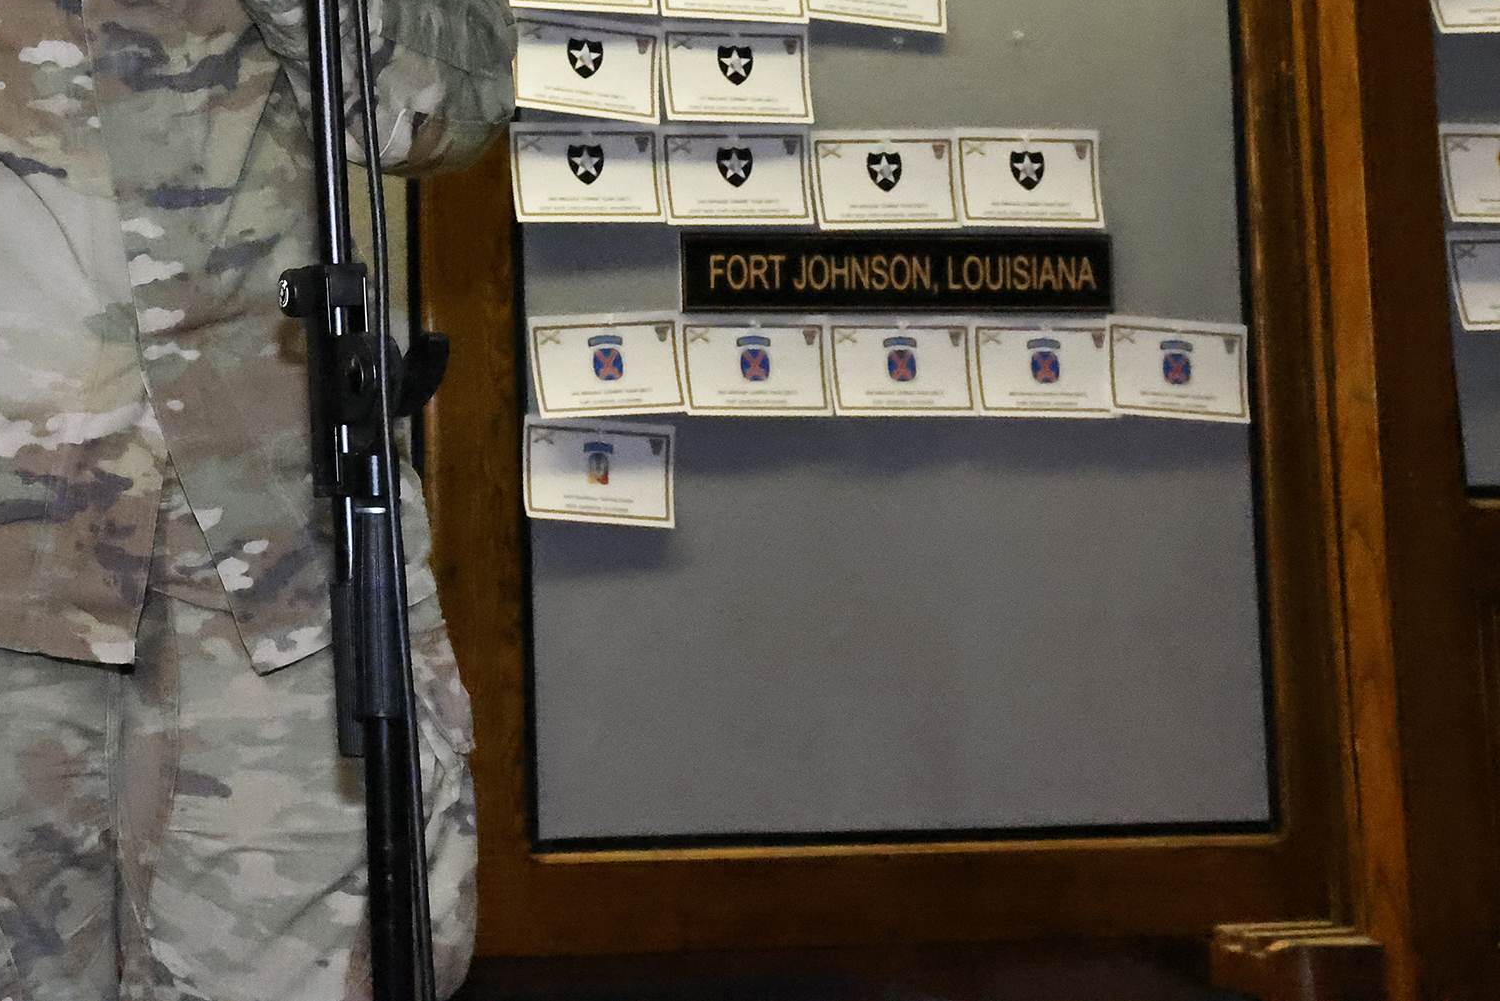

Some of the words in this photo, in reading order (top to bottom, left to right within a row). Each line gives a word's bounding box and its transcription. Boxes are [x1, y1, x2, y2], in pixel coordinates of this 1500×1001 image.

[709, 254, 786, 290] FORT
[792, 254, 939, 294] JOHNSON,
[947, 255, 1097, 291] LOUISIANA
